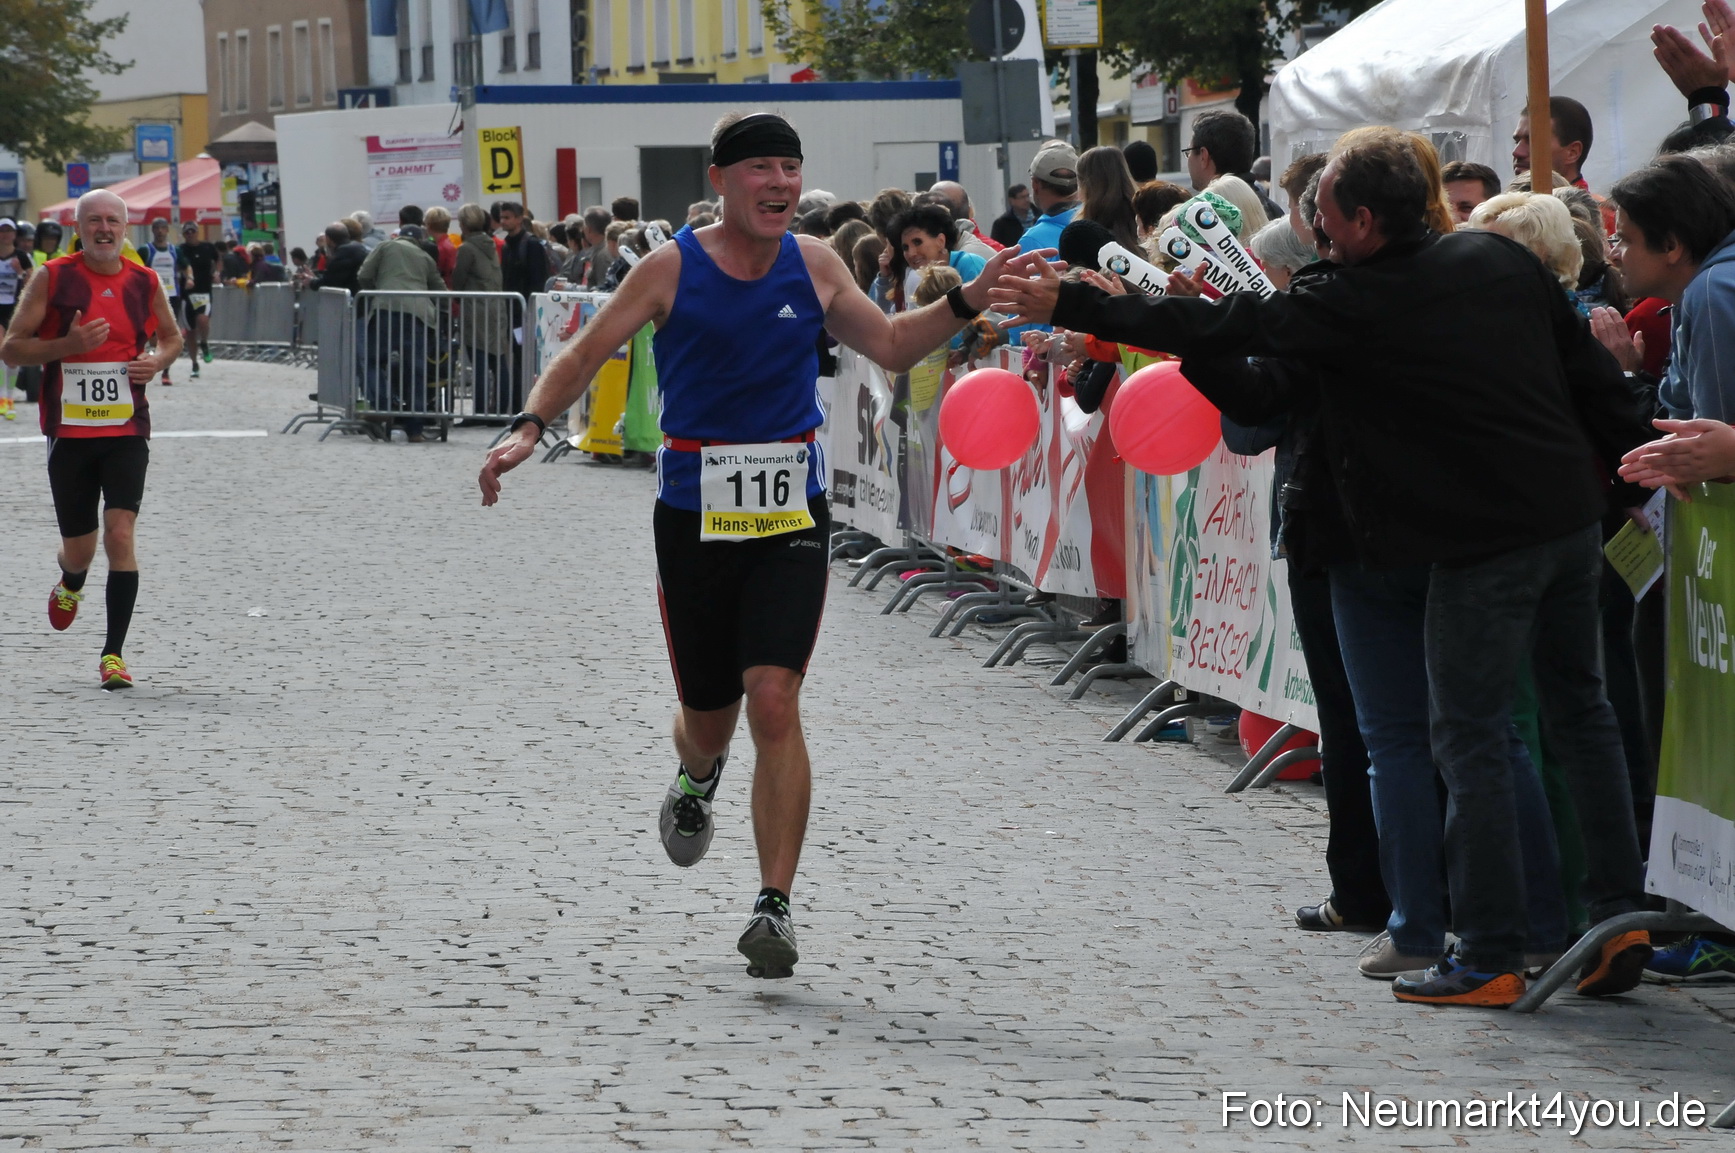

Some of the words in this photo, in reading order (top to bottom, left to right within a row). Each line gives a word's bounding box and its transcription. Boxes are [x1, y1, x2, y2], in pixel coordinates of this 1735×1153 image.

[482, 129, 517, 143] Block
[388, 163, 435, 175] DAHMIT
[490, 146, 514, 180] D
[1138, 272, 1168, 296] bm
[86, 368, 119, 376] Neumarkt
[76, 378, 119, 402] 189
[85, 408, 110, 417] Peter
[744, 454, 794, 465] Neumarkt
[726, 469, 791, 508] 116
[712, 516, 803, 533] Hans-Werner
[800, 540, 821, 549] asics
[1697, 526, 1717, 580] Der
[1685, 575, 1728, 674] Neue
